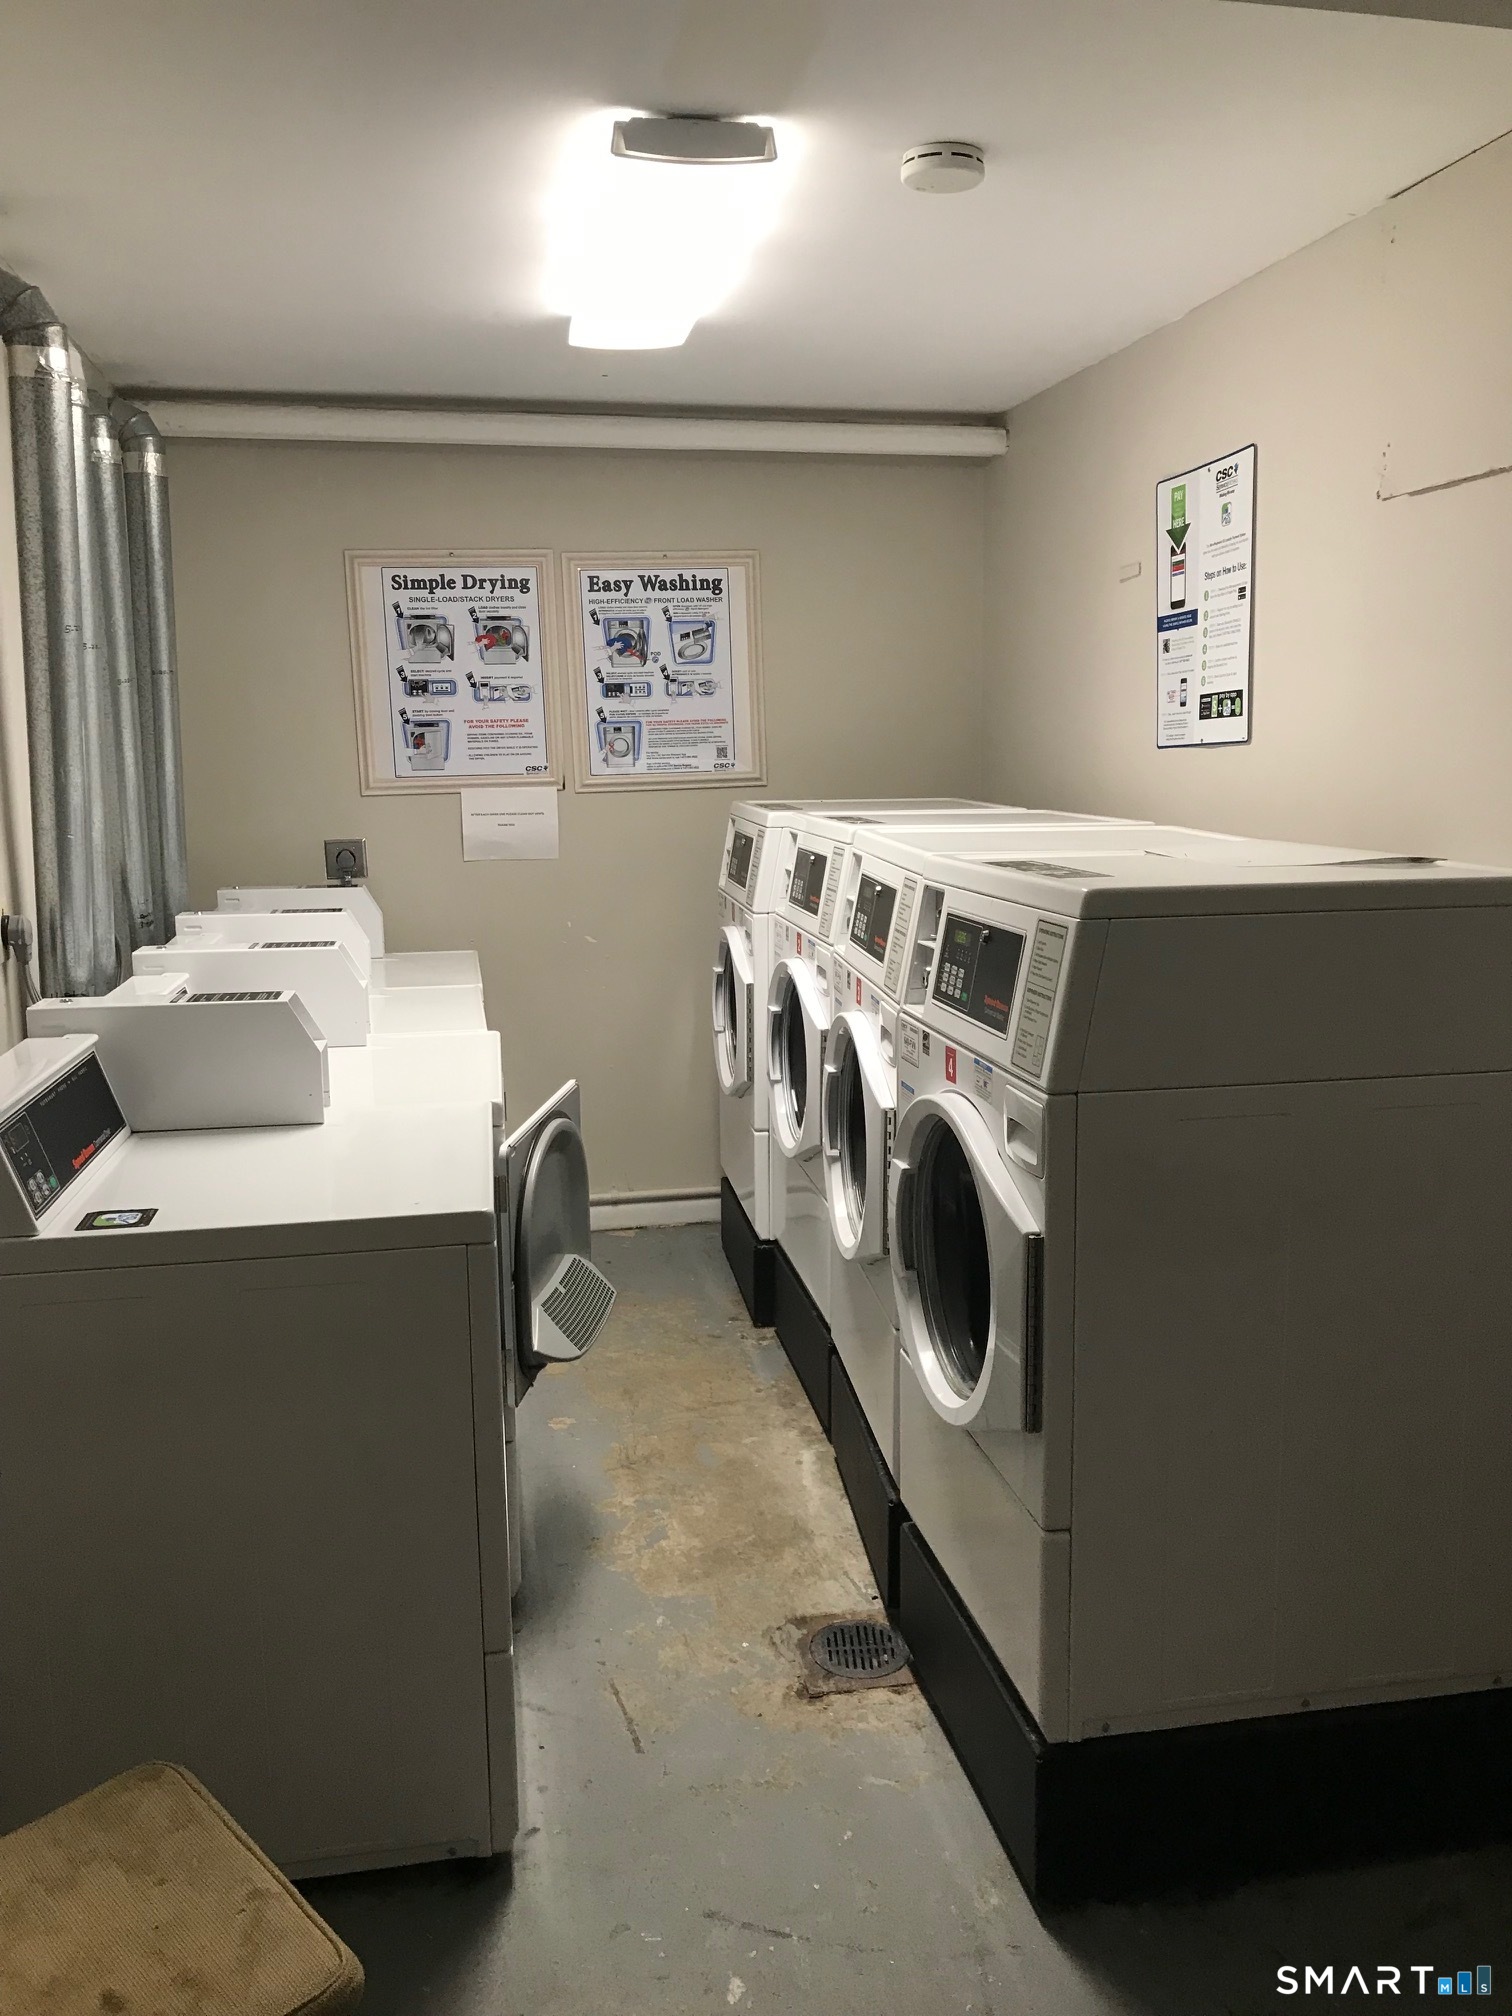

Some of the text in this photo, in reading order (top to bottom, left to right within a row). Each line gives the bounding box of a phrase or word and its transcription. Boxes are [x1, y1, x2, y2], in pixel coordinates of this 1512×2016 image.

[1216, 465, 1233, 482] CSC
[1174, 490, 1184, 502] PAY
[1173, 516, 1185, 529] HERE
[1204, 571, 1216, 581] Steps
[1216, 569, 1222, 578] on
[1222, 566, 1232, 576] How
[1232, 564, 1237, 573] to
[391, 574, 530, 595] Simple Drying
[587, 573, 723, 597] Easy Washing
[948, 1057, 954, 1077] 4
